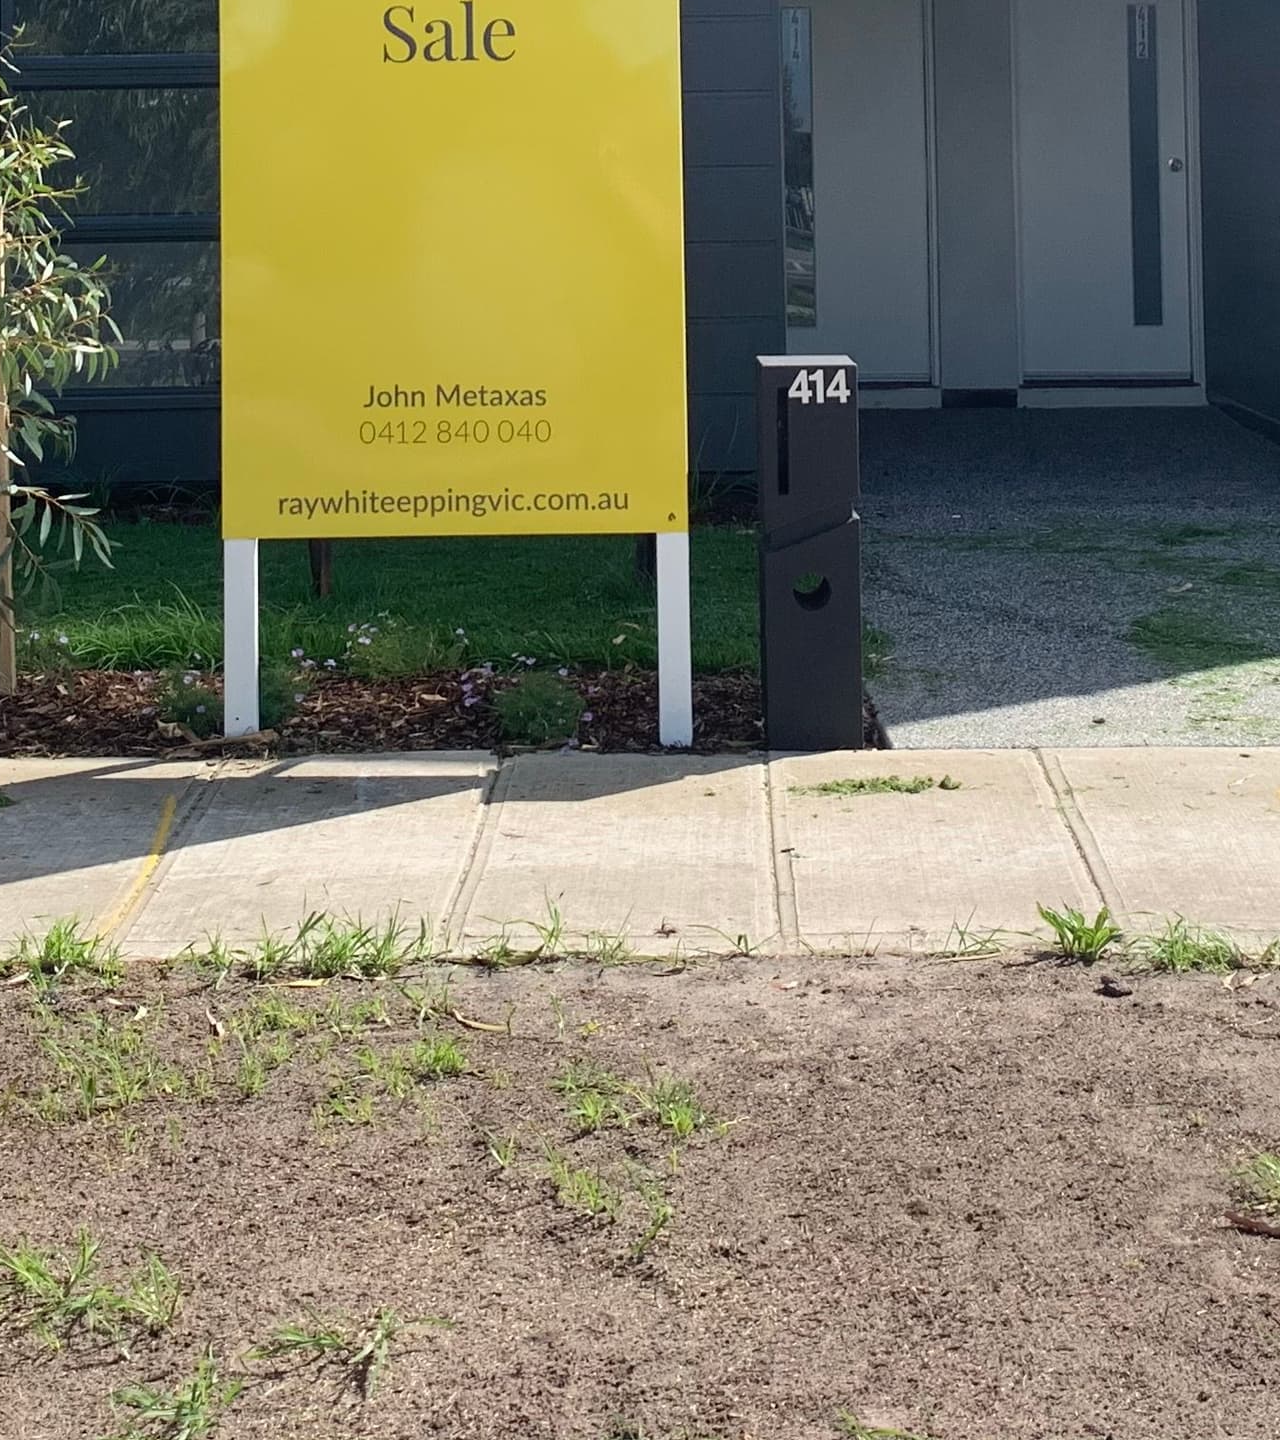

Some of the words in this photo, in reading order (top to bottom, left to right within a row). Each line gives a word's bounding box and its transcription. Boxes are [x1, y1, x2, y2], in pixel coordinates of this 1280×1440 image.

[383, 0, 517, 64] Sale
[363, 383, 426, 409] John
[436, 383, 548, 408] Metaxas
[788, 368, 851, 404] 414
[358, 420, 427, 445] 0412
[436, 420, 490, 444] 840
[497, 419, 552, 444] 040
[278, 487, 630, 521] raywhiteeppingvic.com.au
